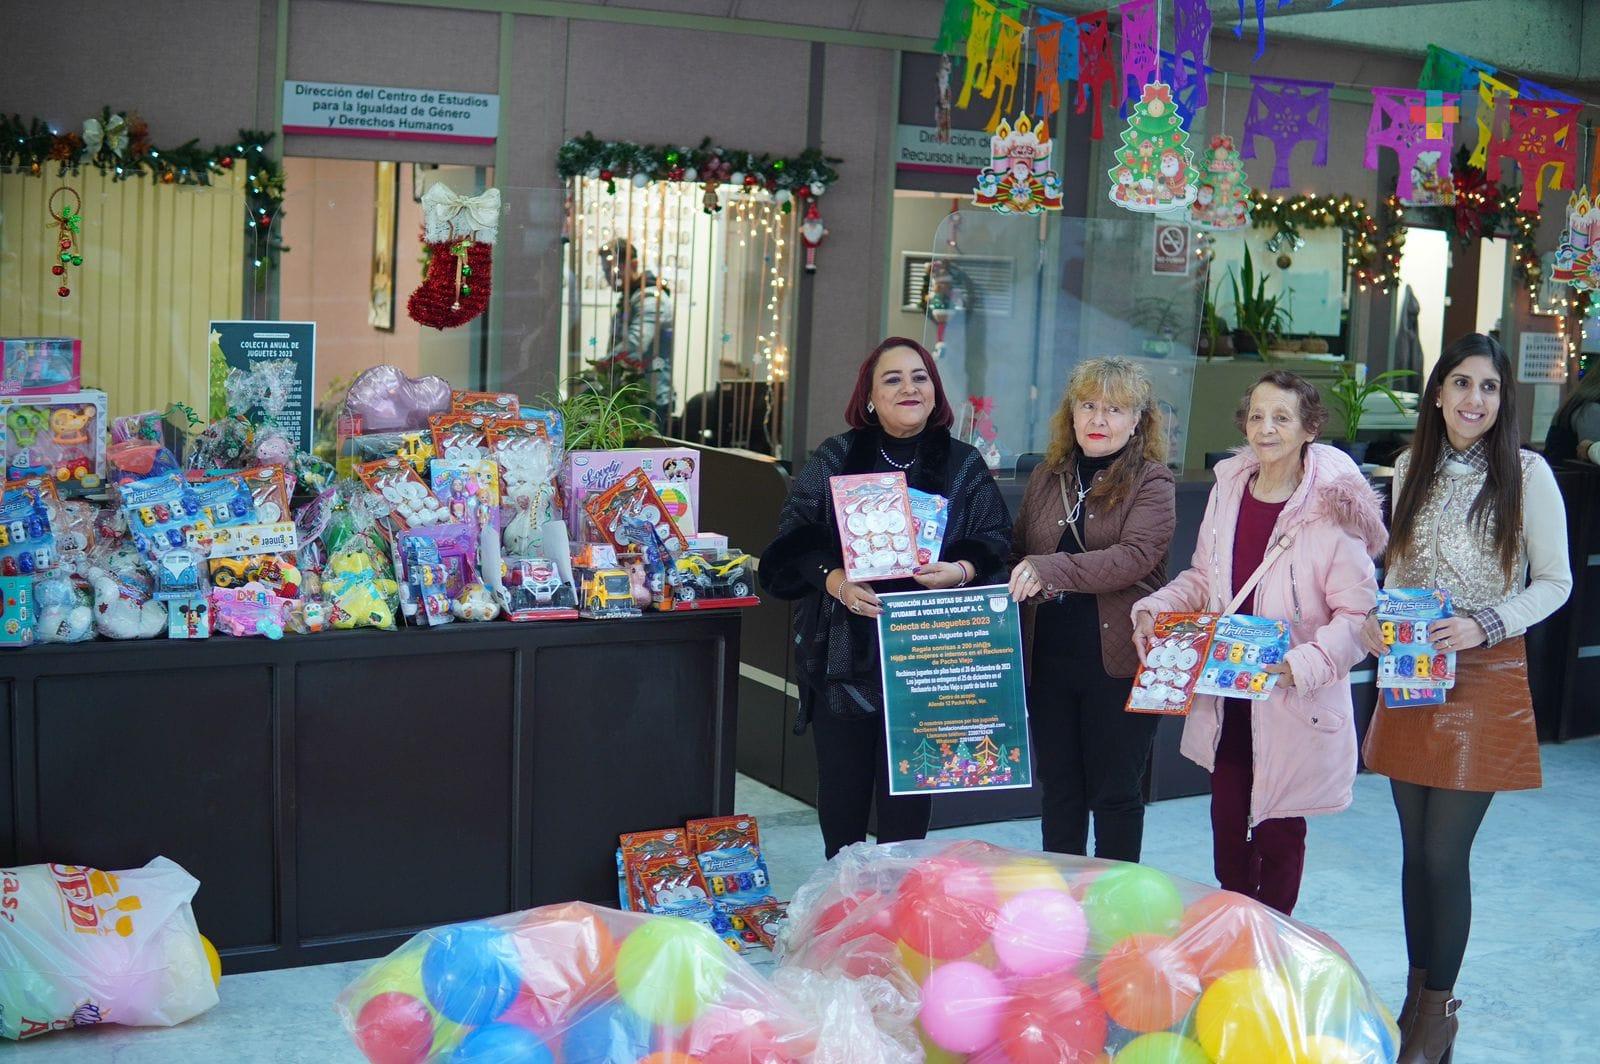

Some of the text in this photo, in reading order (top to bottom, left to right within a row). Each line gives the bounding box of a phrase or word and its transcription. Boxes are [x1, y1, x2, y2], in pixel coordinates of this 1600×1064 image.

[296, 84, 489, 107] Dirección del Centro de Estudios
[313, 101, 471, 119] para la Igualdad de Género
[328, 114, 454, 132] y Derechos Humanos
[920, 130, 976, 147] Dirción
[902, 147, 953, 164] Recursos
[582, 459, 621, 486] Lovely
[923, 608, 944, 616] VOLVER
[890, 622, 920, 632] Colecta
[920, 621, 930, 629] de
[971, 617, 990, 626] 2023
[938, 632, 963, 640] Juguete
[974, 629, 989, 637] pilas
